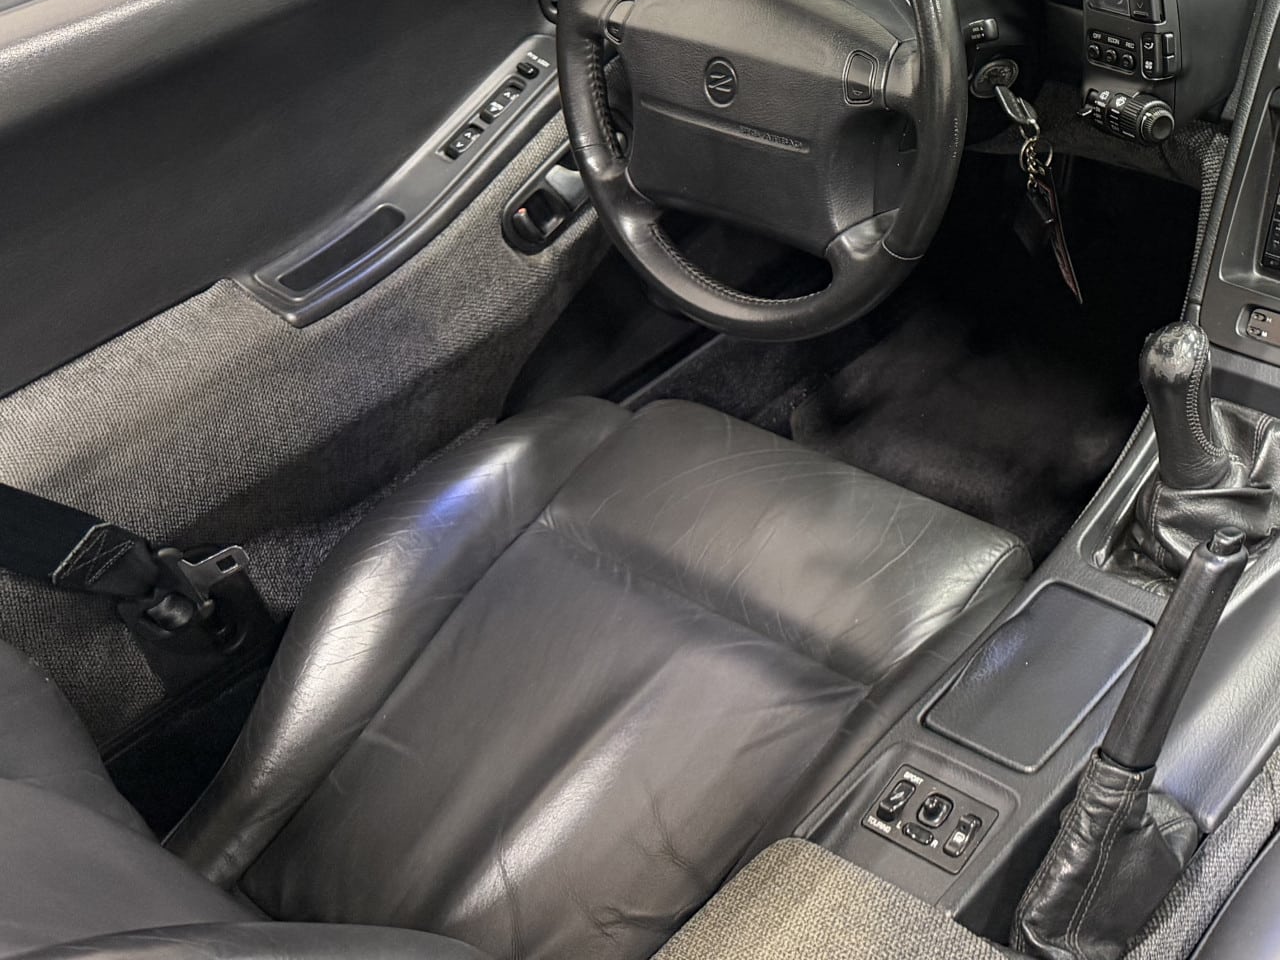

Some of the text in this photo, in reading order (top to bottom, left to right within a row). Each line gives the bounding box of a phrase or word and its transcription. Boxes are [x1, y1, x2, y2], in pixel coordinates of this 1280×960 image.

[1107, 36, 1120, 45] ECON
[1125, 41, 1135, 49] REC
[903, 771, 924, 786] SPORT
